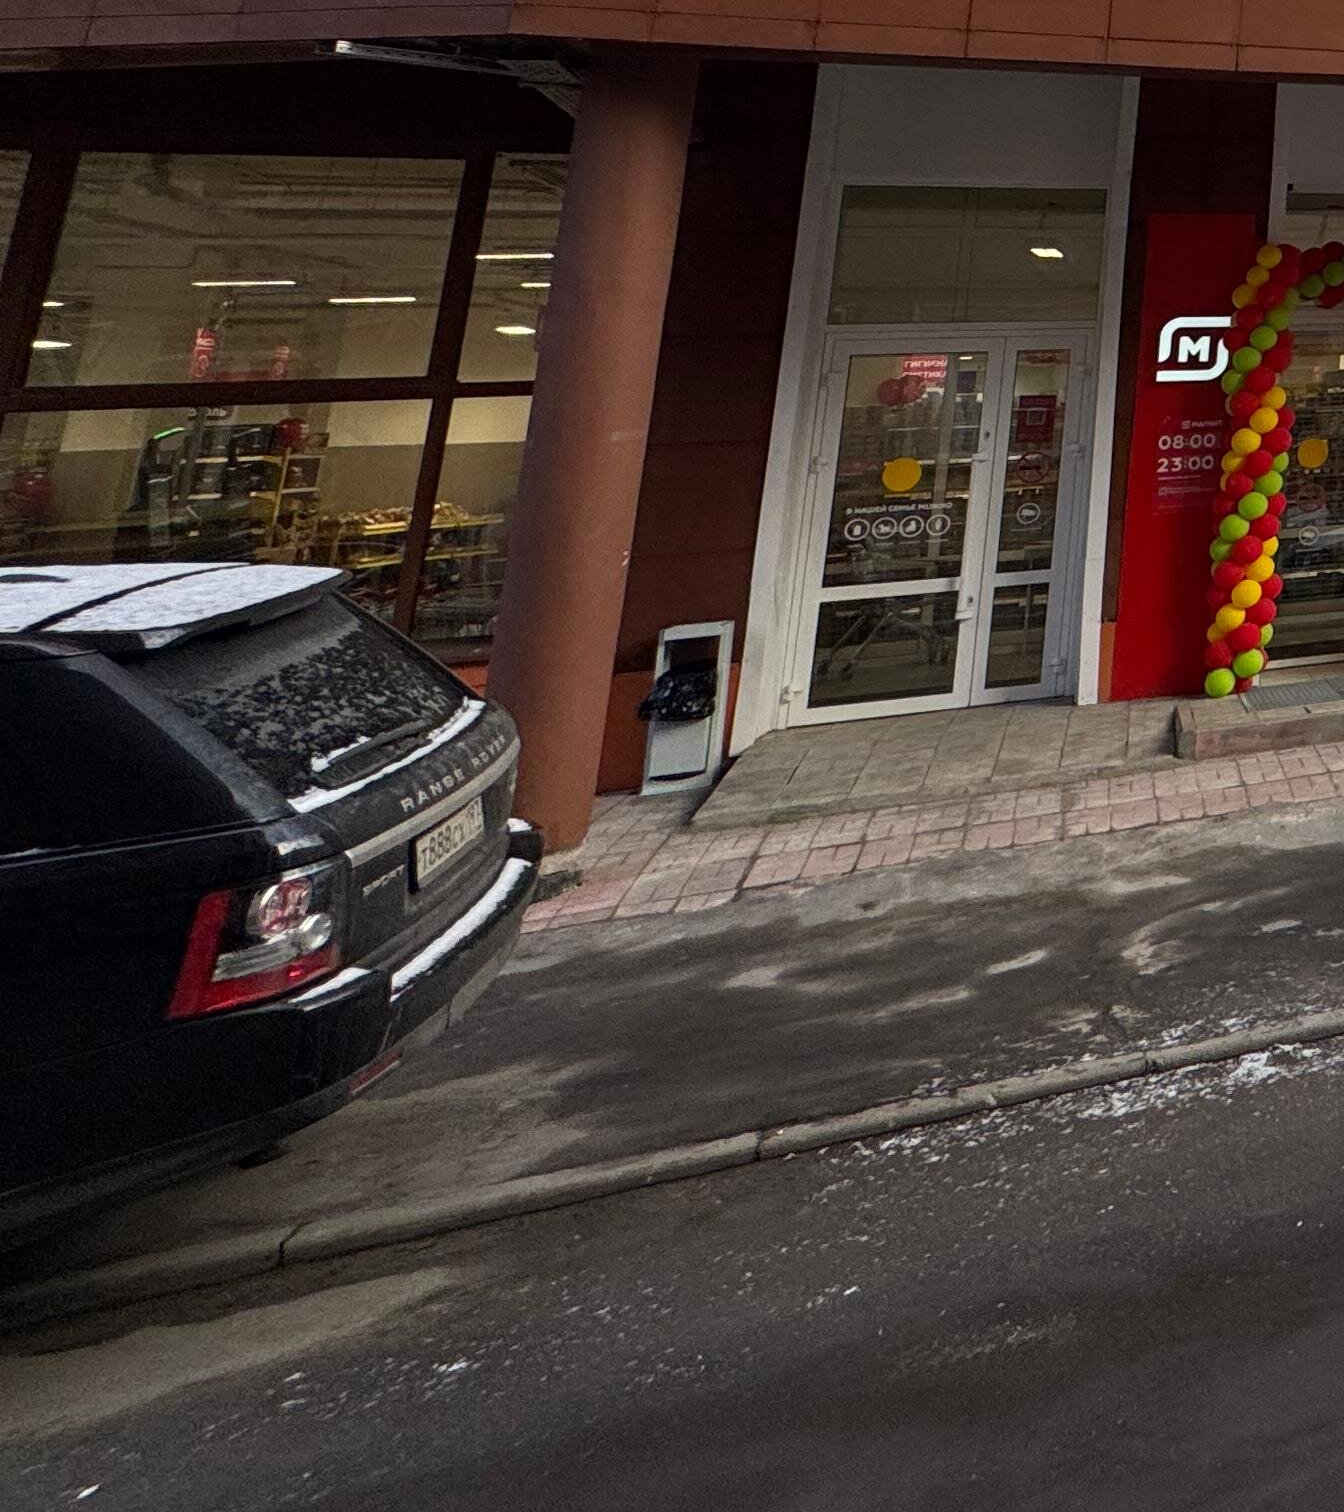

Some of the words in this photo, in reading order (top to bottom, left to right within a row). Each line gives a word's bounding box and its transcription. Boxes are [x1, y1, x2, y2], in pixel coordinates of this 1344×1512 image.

[1157, 433, 1217, 451] 08:00
[1156, 455, 1215, 473] 23:00
[400, 768, 465, 813] RANGE
